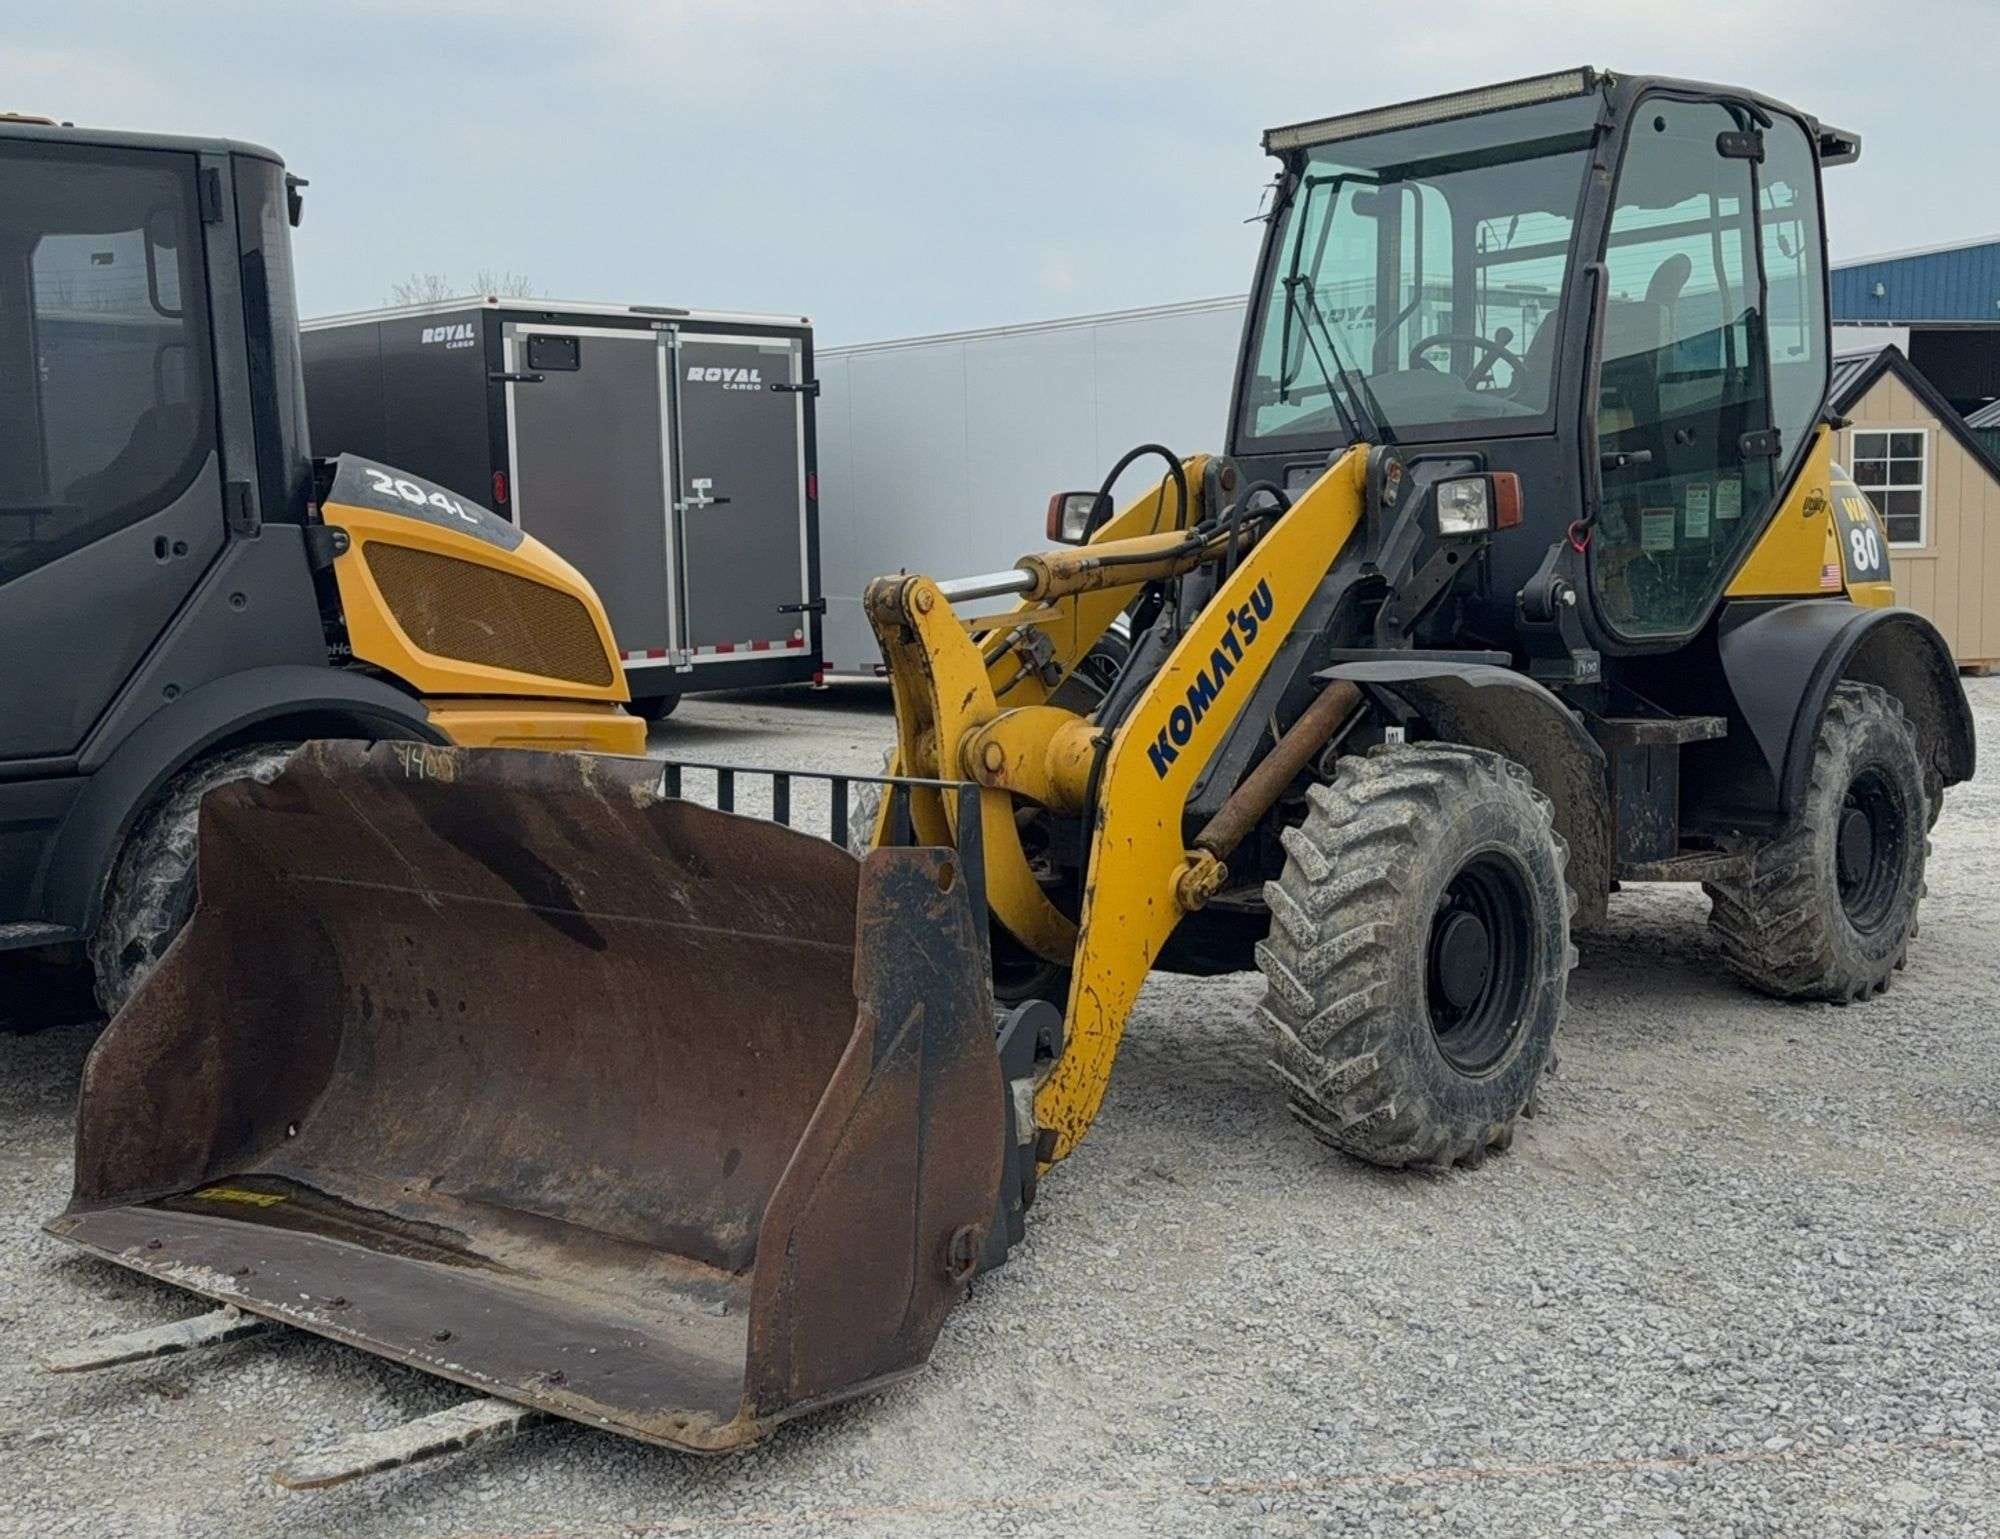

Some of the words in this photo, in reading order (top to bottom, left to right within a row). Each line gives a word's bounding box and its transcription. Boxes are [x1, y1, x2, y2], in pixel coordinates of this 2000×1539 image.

[422, 323, 474, 343] ROYAL
[446, 340, 475, 349] CARGO
[687, 367, 762, 383] ROYAL
[365, 469, 478, 524] 204L
[1841, 497, 1869, 522] WA
[1850, 528, 1880, 571] 80
[1147, 582, 1273, 780] KOMATSU
